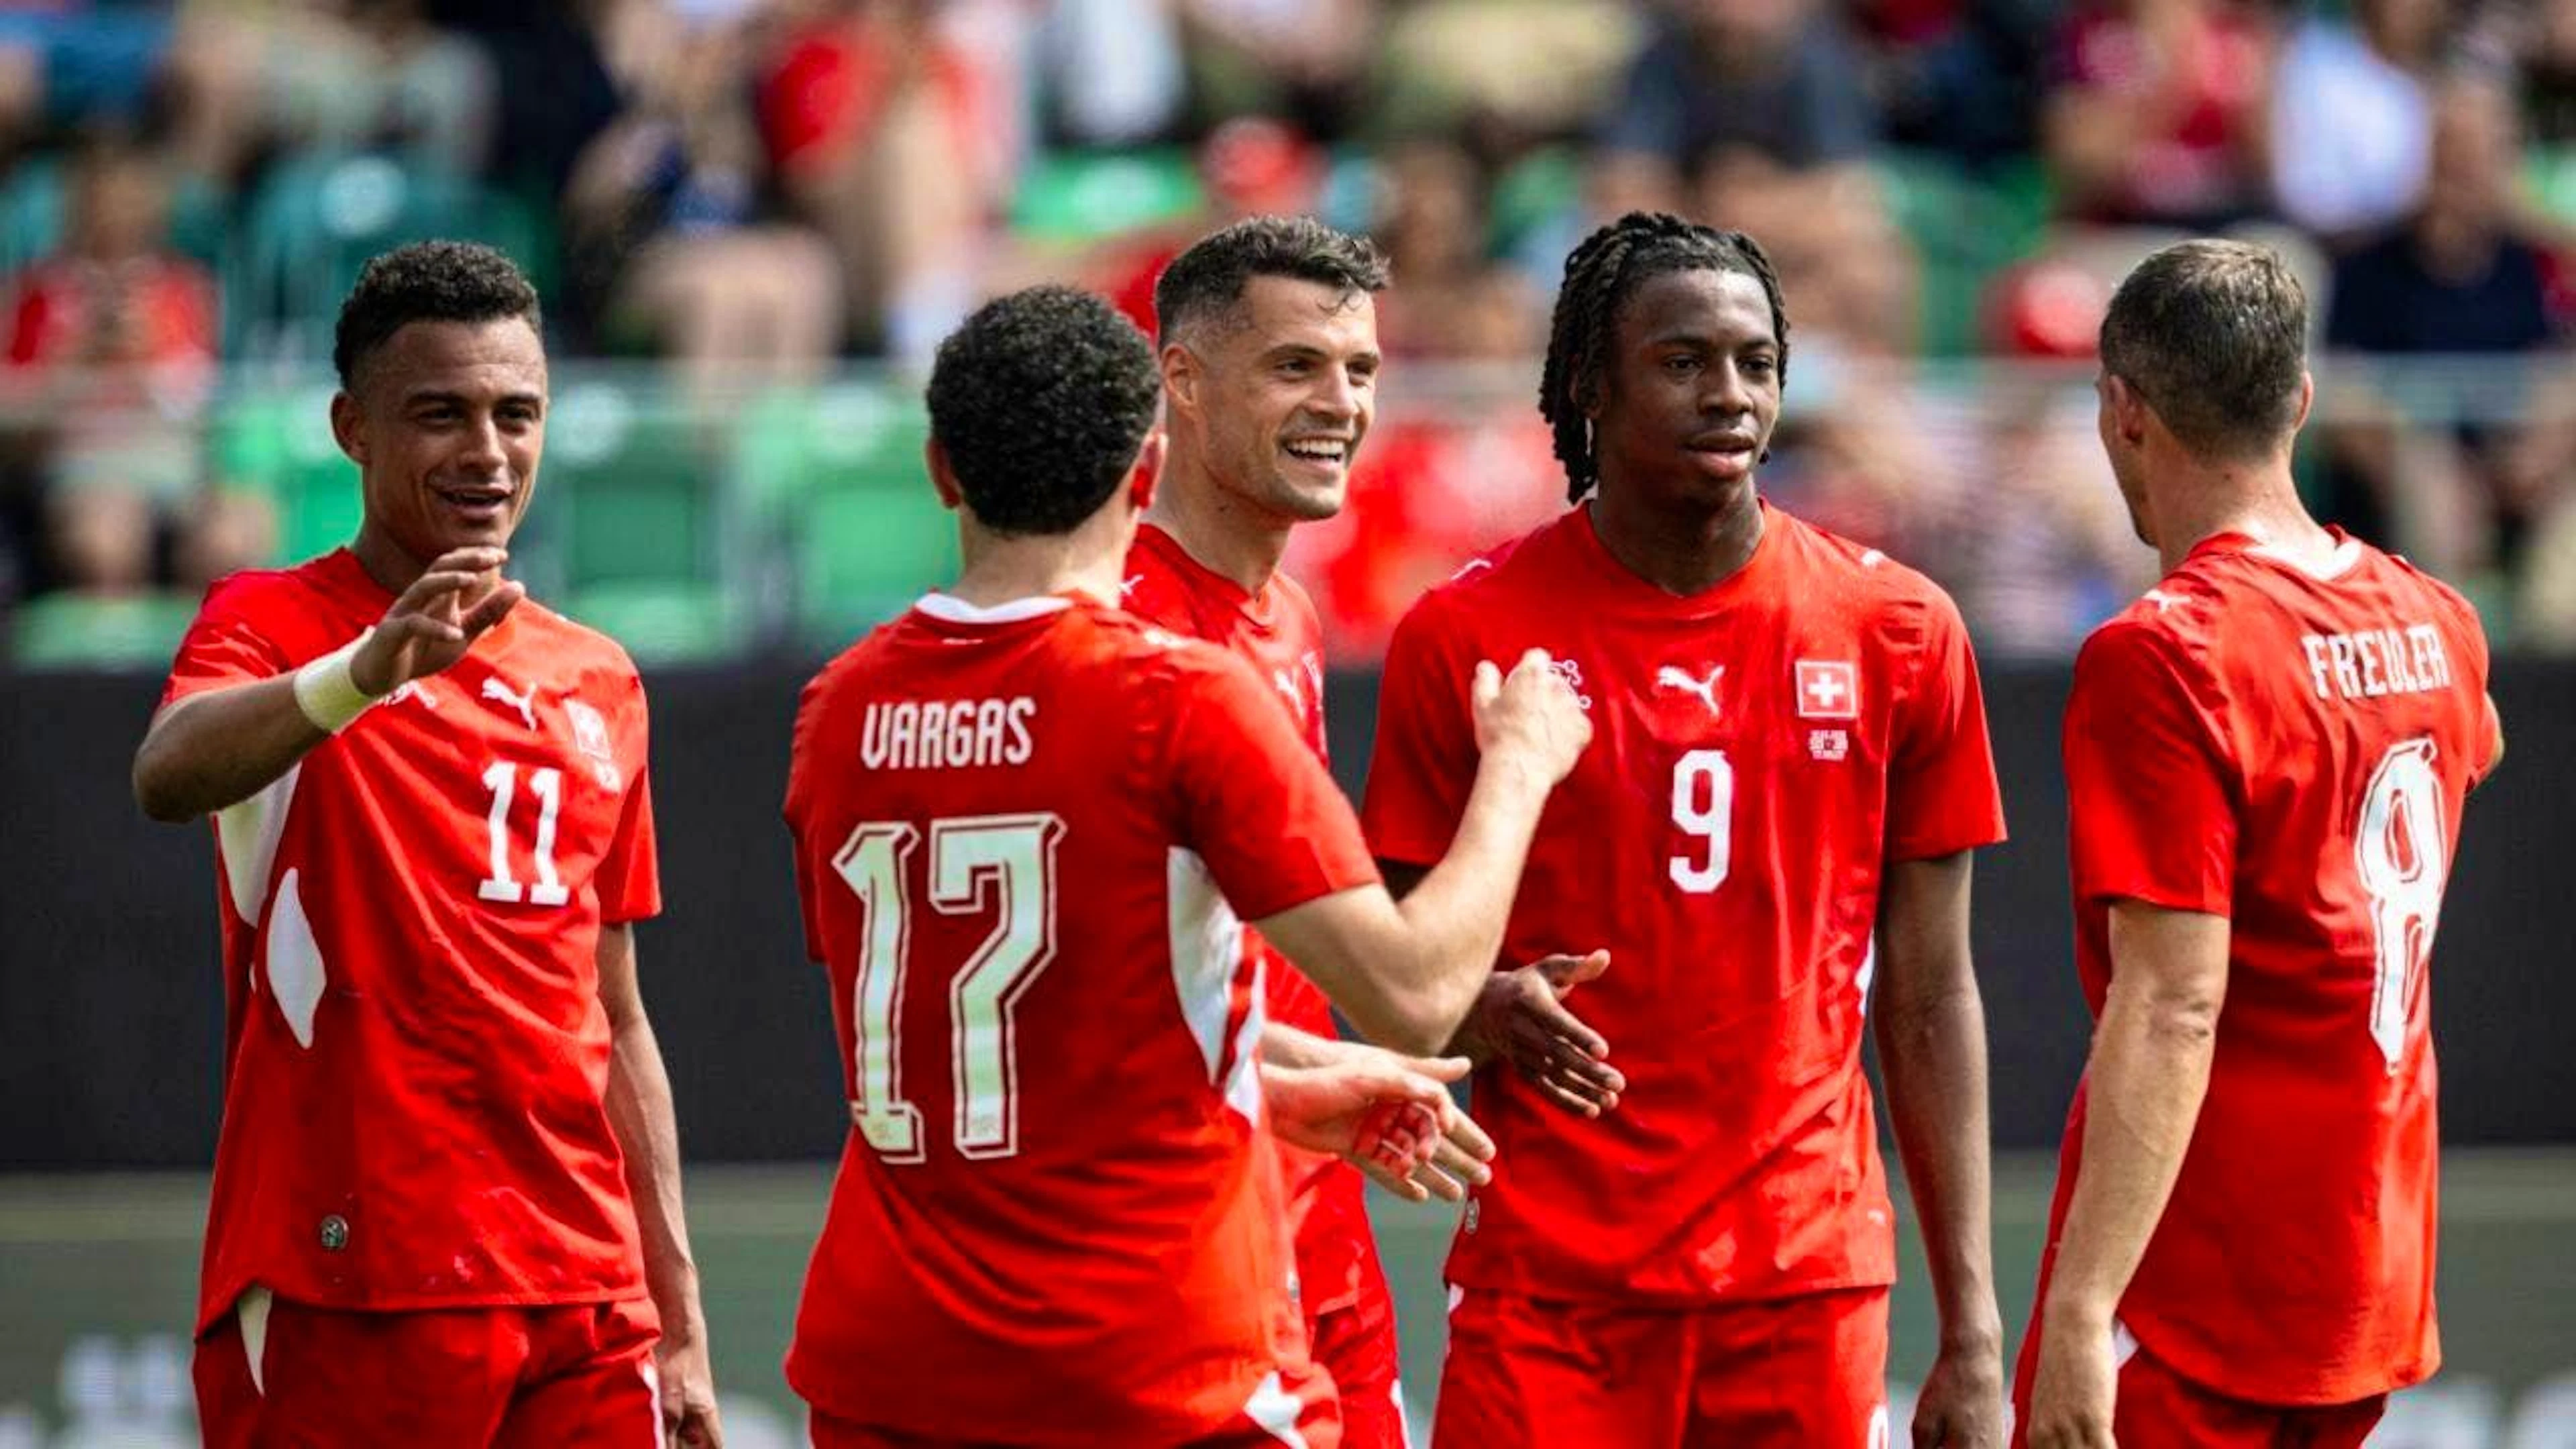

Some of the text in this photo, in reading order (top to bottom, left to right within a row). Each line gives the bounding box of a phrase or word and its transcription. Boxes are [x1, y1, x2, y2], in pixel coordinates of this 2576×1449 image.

[861, 696, 1036, 770] VARGAS
[478, 761, 569, 906] 11
[1669, 749, 1732, 894] 9
[2354, 737, 2447, 1077] 8
[832, 812, 1067, 1165] 17
